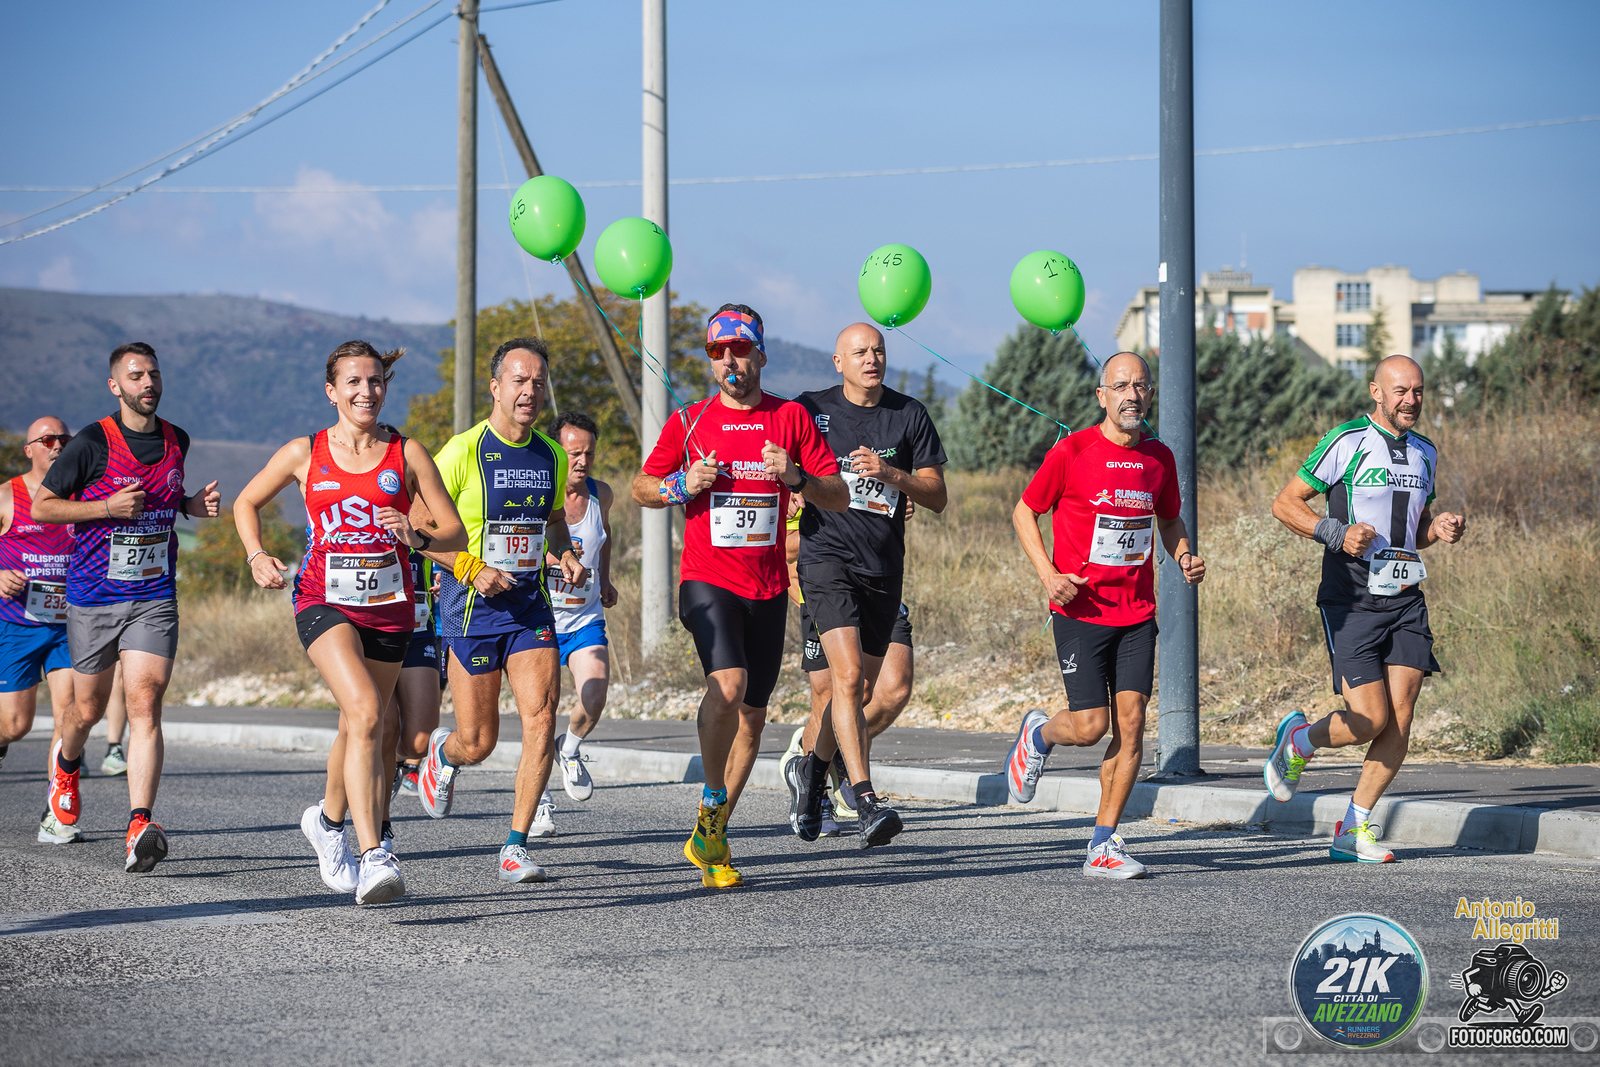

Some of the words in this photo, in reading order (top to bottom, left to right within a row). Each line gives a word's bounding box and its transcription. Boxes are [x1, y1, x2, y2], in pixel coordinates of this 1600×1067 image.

[732, 461, 766, 472] RUNNE
[493, 468, 550, 489] BRIGANTI
[855, 478, 885, 498] 299
[723, 497, 741, 507] 21K
[736, 510, 757, 529] 39
[1108, 520, 1125, 529] 21K
[499, 525, 515, 534] 10K
[123, 536, 140, 545] 21K
[506, 536, 529, 554] 193
[1117, 532, 1136, 549] 46
[127, 547, 156, 566] 274
[341, 558, 361, 568] 21K
[25, 568, 67, 577] CAPISTRE
[1392, 562, 1409, 579] 66
[356, 571, 379, 591] 56
